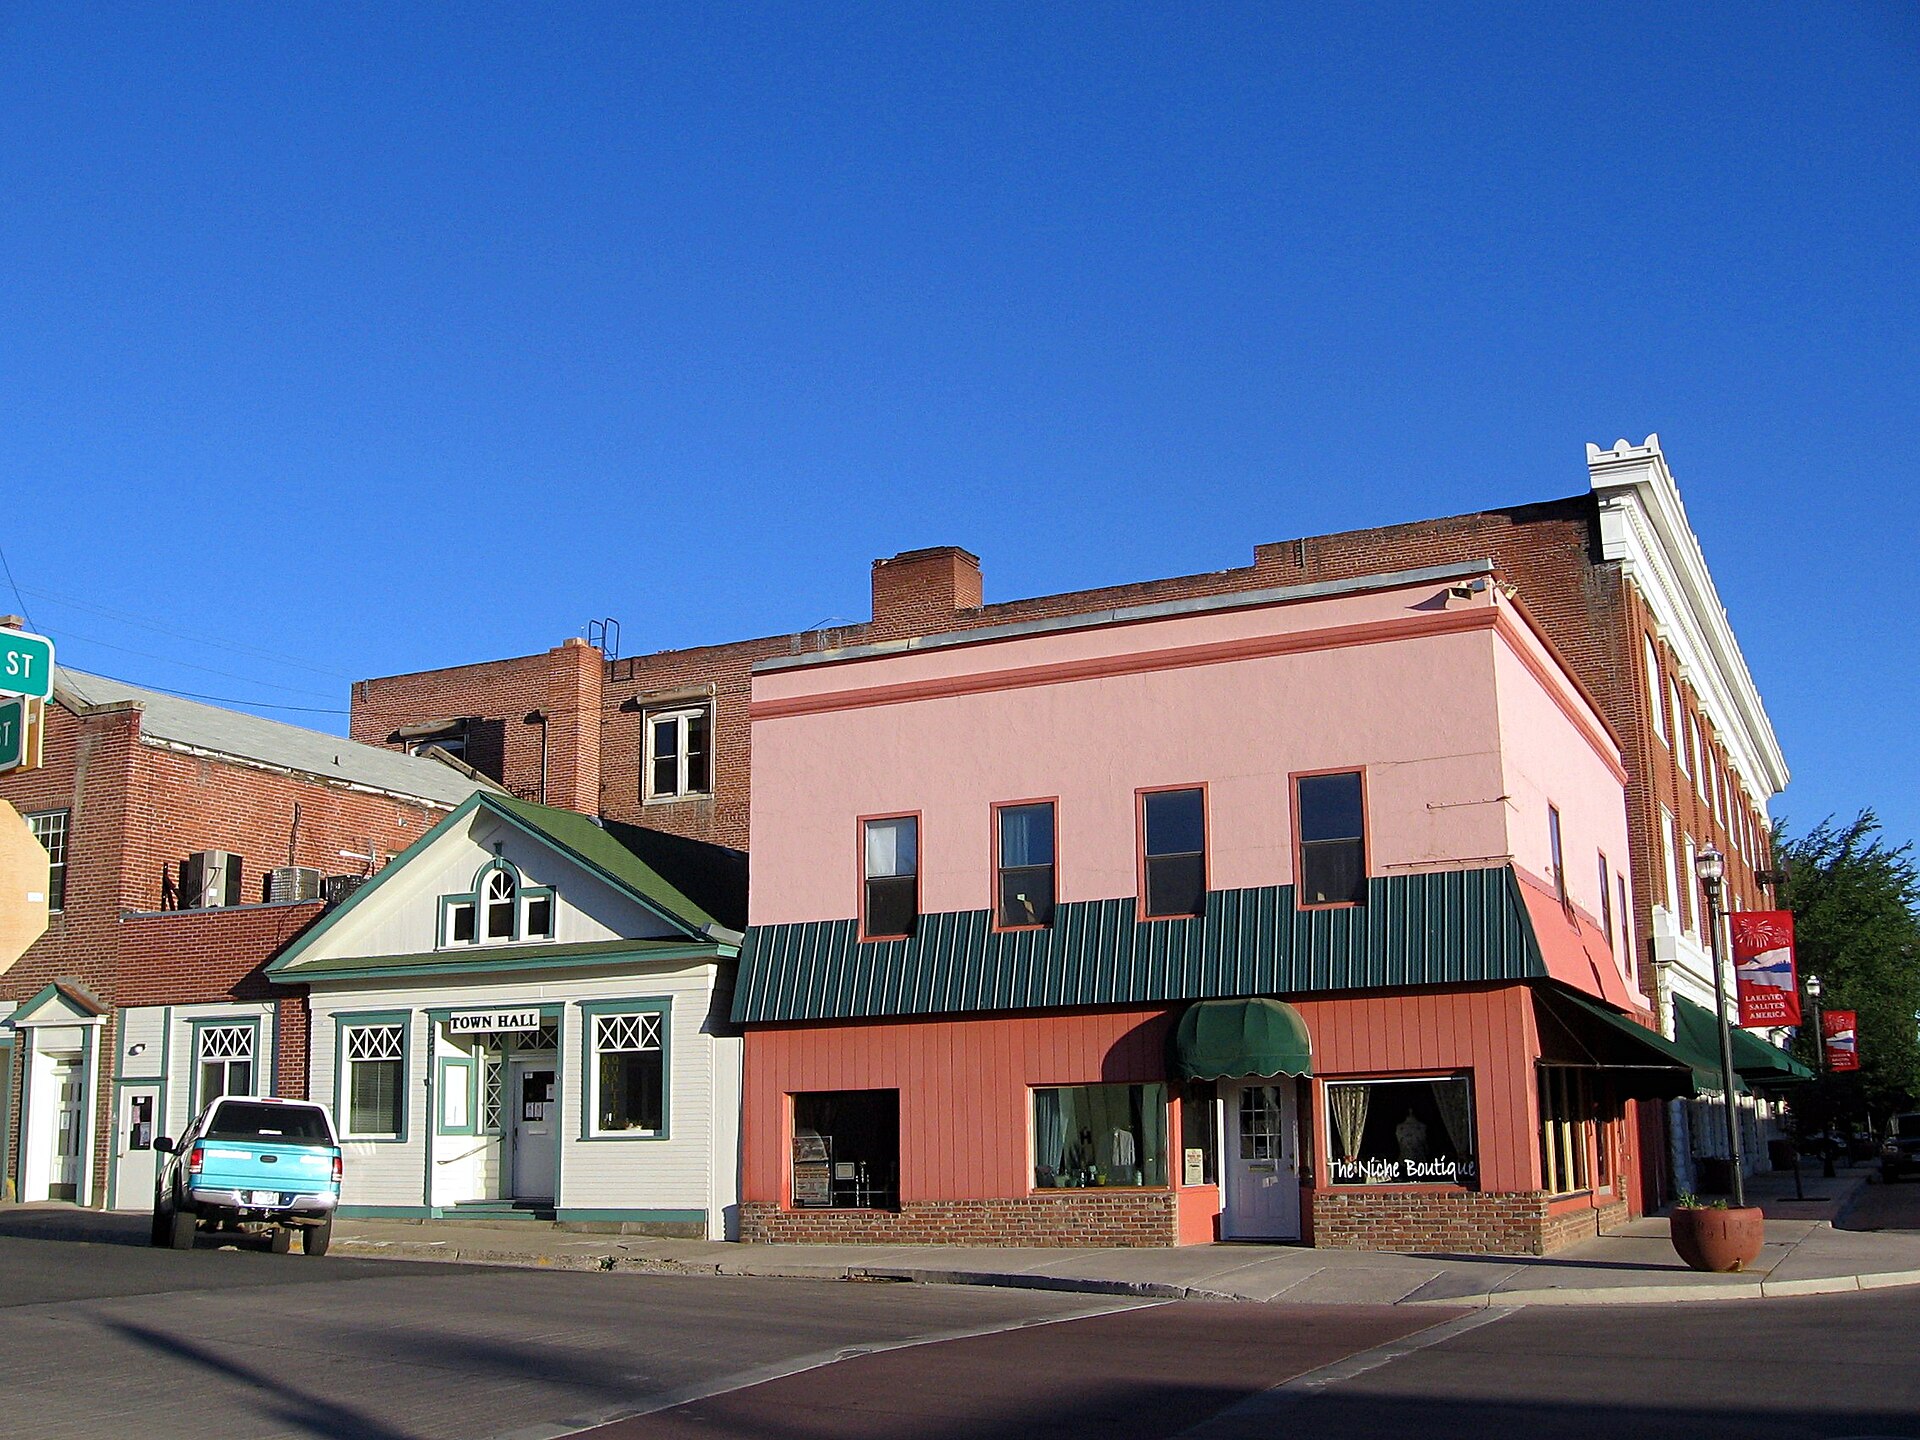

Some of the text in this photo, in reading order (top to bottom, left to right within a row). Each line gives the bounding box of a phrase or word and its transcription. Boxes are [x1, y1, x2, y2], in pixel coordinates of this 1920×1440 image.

[6, 650, 34, 679] ST
[1749, 1001, 1786, 1011] SALUTES
[450, 1014, 537, 1030] TOWN HALL
[1749, 1010, 1787, 1019] AMERICA
[1327, 1154, 1476, 1183] The Niche Boutique
